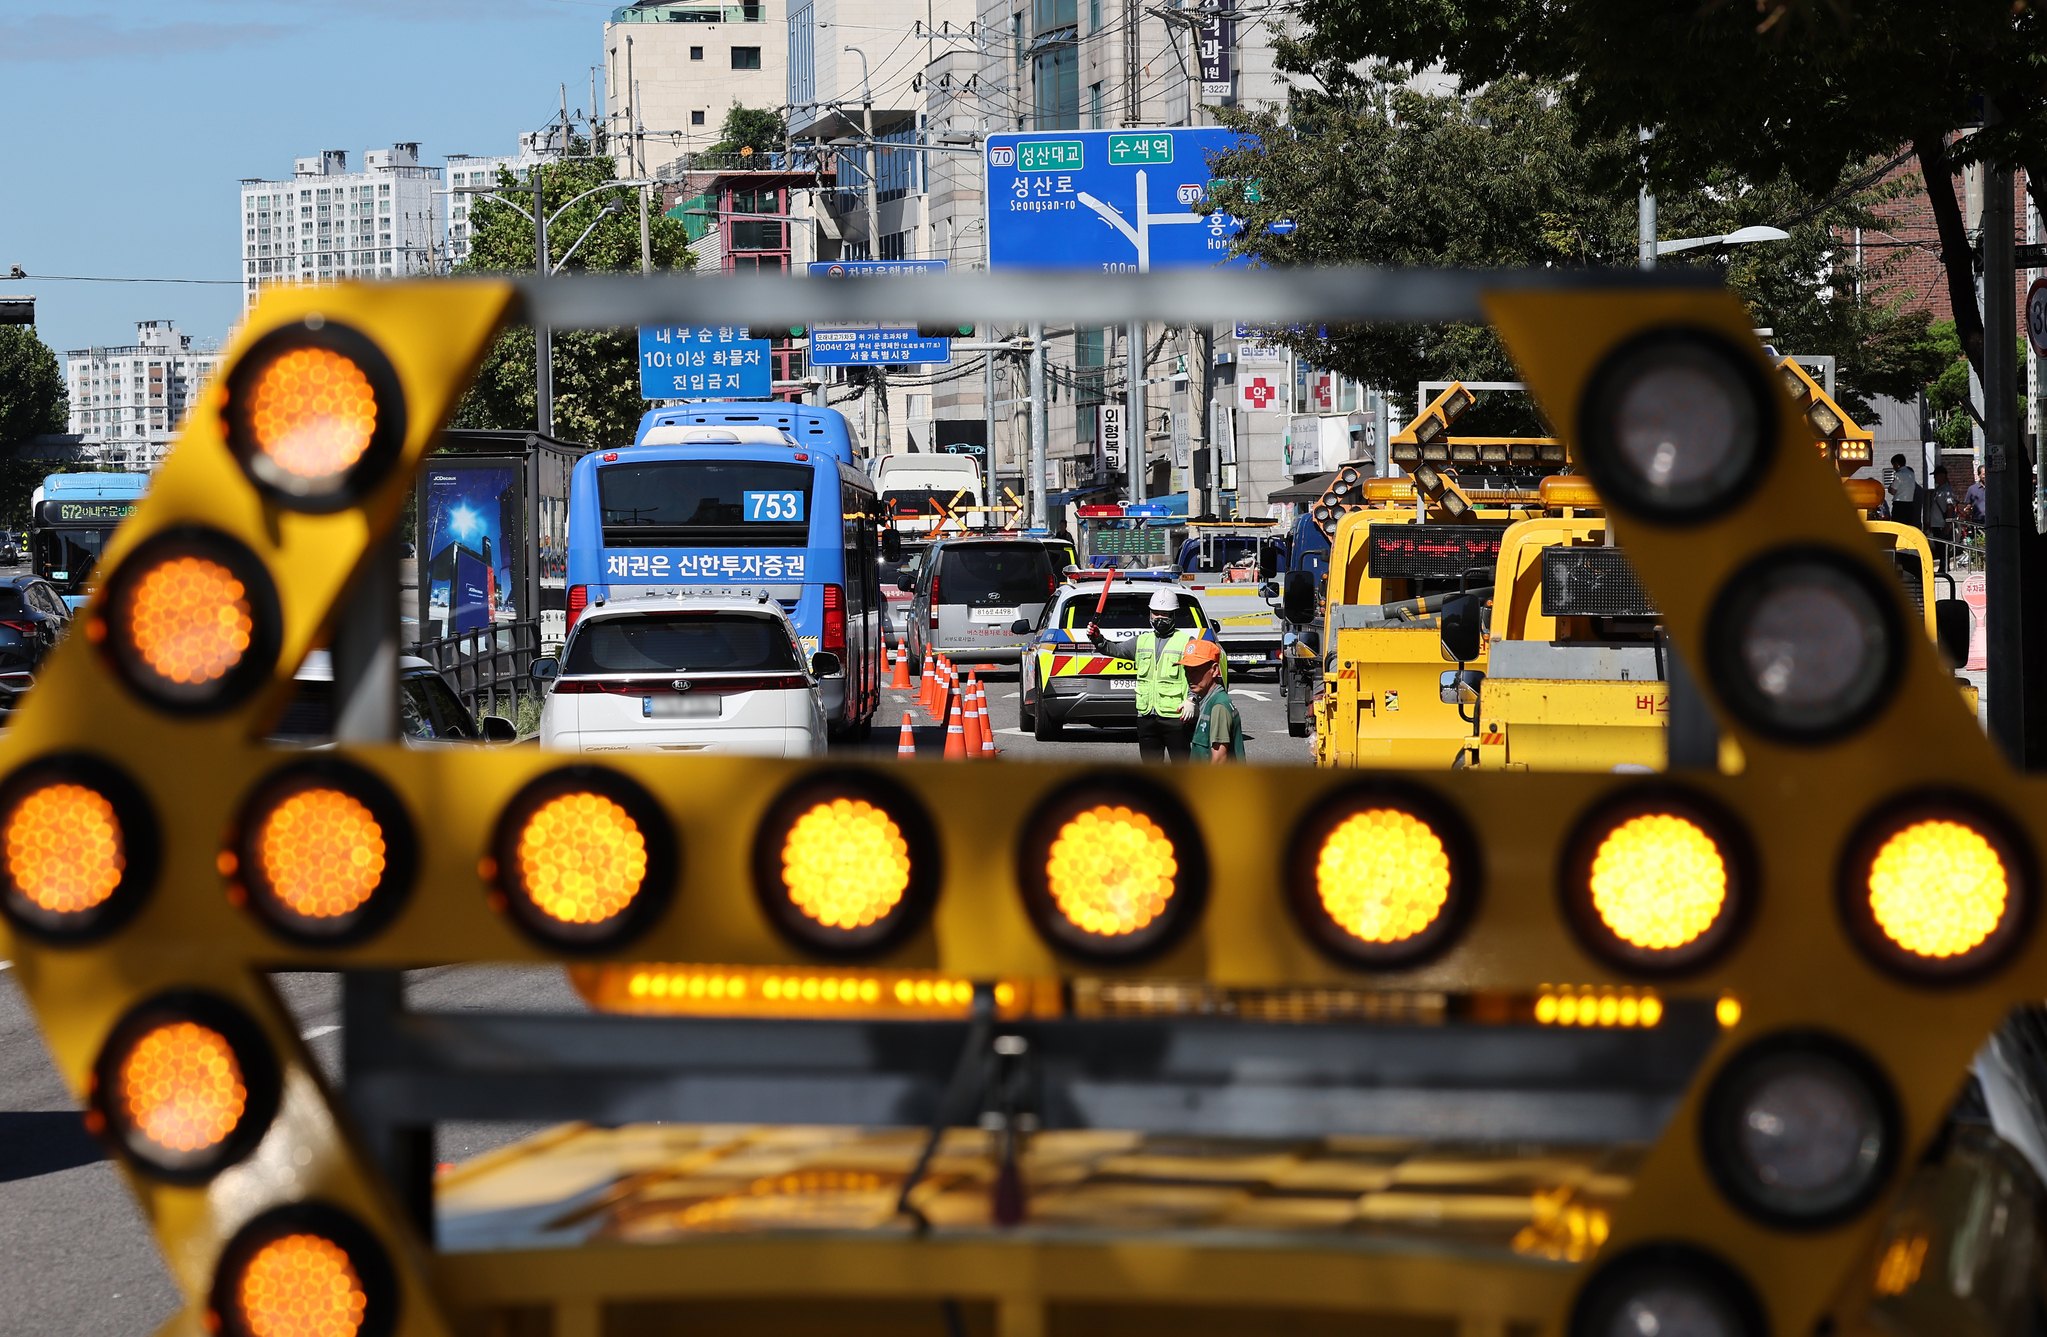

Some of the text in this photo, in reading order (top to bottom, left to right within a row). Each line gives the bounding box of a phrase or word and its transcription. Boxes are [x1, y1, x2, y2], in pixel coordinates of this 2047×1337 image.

[1022, 146, 1079, 166] 성산대교
[1114, 139, 1168, 159] 수색역
[994, 151, 1010, 163] 70
[1011, 176, 1074, 198] 성산로
[1181, 188, 1199, 200] 30
[1010, 199, 1076, 213] Seongsan-ro
[1102, 262, 1137, 275] 300m
[656, 327, 752, 344] 내부순환로
[815, 342, 842, 351] 2004년
[844, 342, 856, 351] 2월
[858, 342, 872, 350] 부터
[644, 349, 760, 368] 10t 이상 화물차
[850, 350, 910, 361] 서울특별시장
[673, 373, 740, 390] 진입금지
[1253, 387, 1267, 401] 약
[61, 504, 82, 519] 672
[750, 493, 797, 519] 753
[607, 555, 805, 577] 채권은 신한투자증권
[1967, 584, 1986, 593] 주차금
[1117, 662, 1138, 671] POL
[675, 681, 688, 689] KIA
